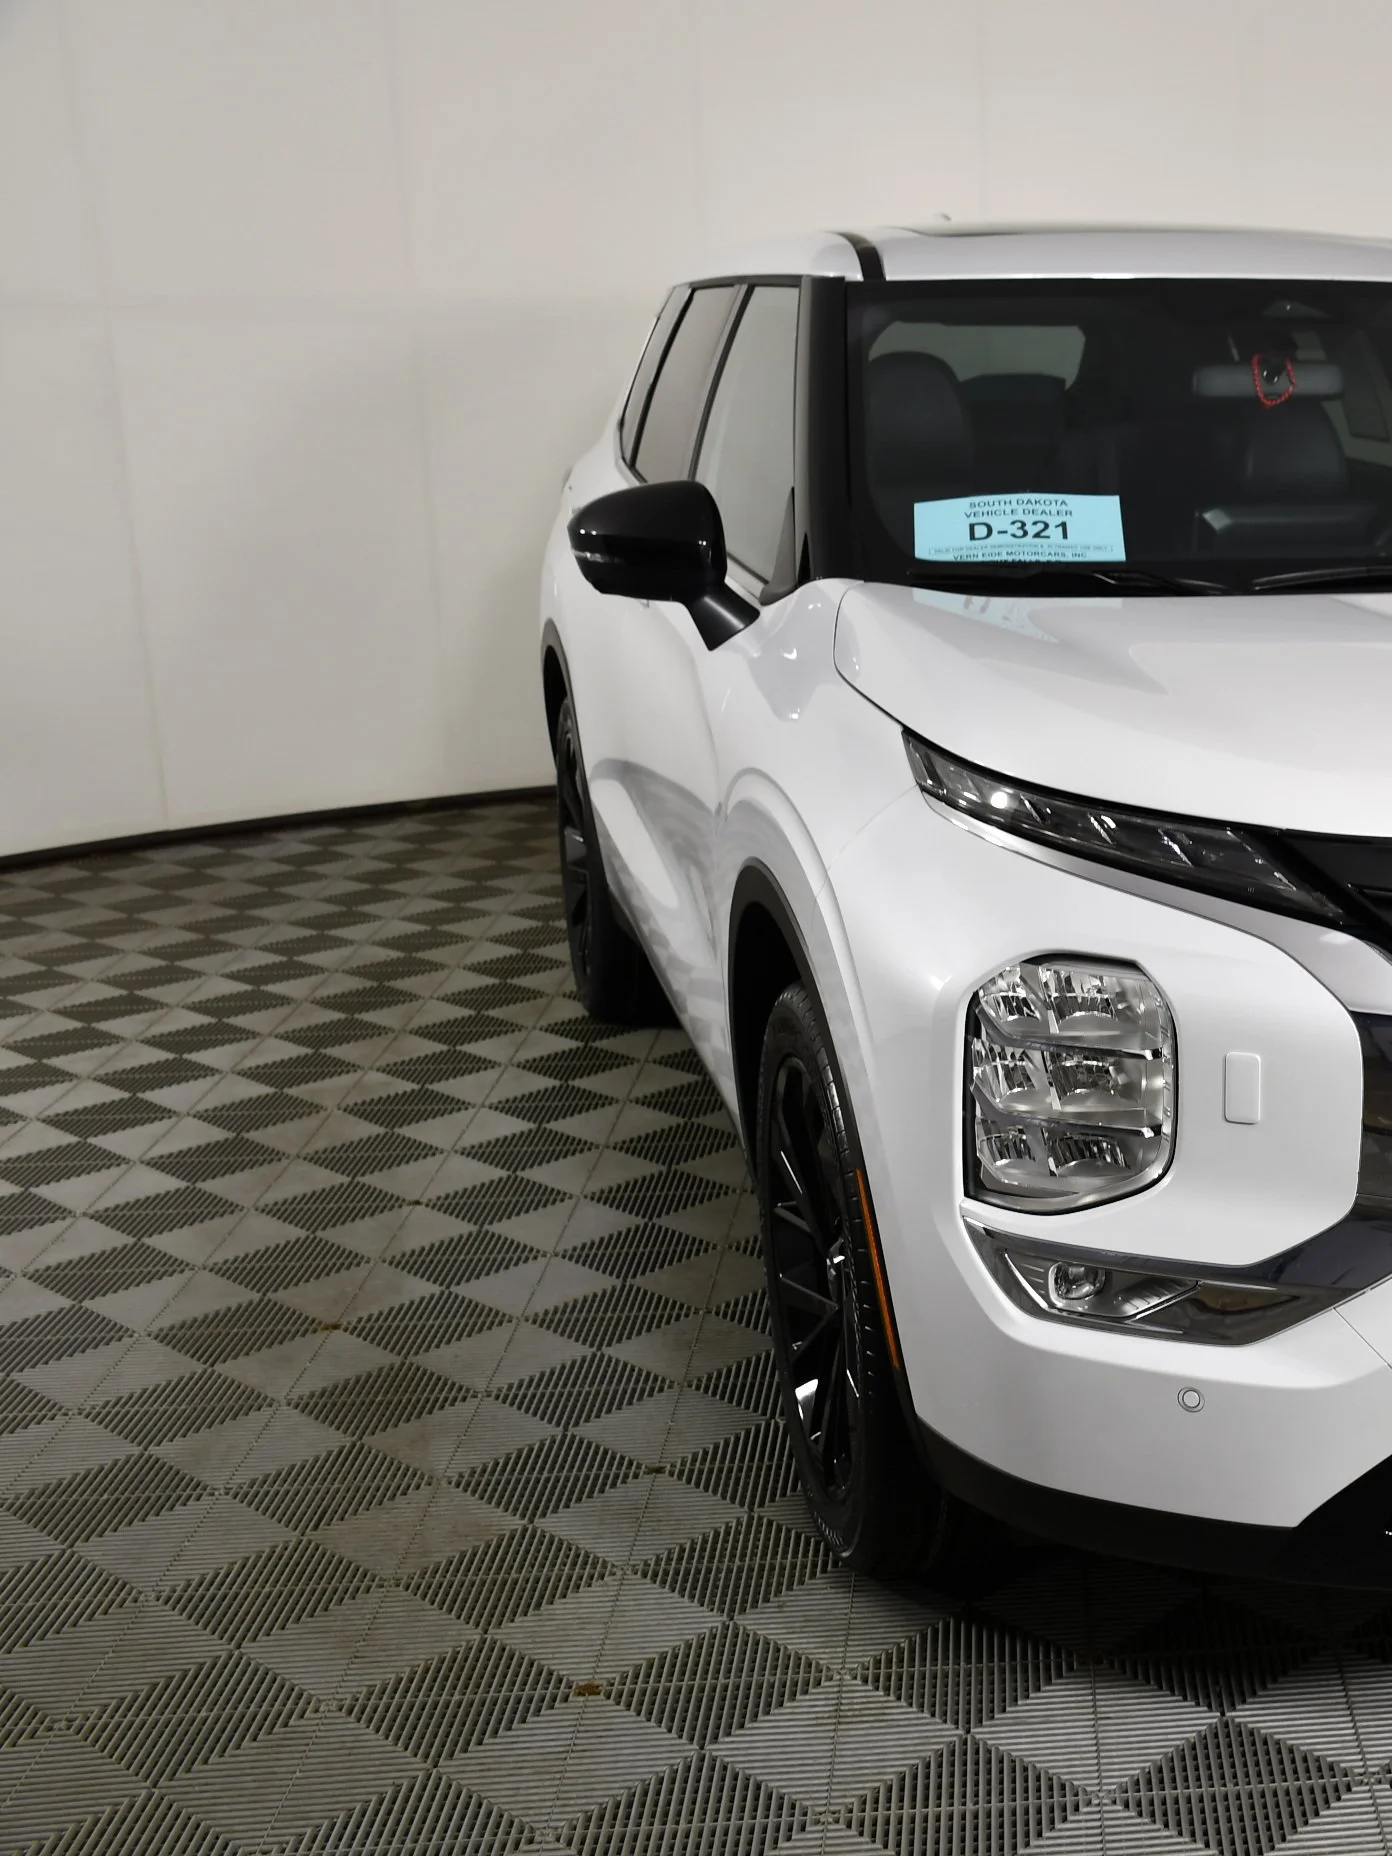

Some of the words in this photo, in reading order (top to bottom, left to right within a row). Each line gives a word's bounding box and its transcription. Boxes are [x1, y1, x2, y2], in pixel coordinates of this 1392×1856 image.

[969, 499, 1012, 509] SOUTH
[1016, 498, 1068, 507] DAKOTA
[964, 508, 1018, 518] VEHICLE
[1022, 508, 1073, 517] DEALER
[968, 520, 1068, 541] D-321
